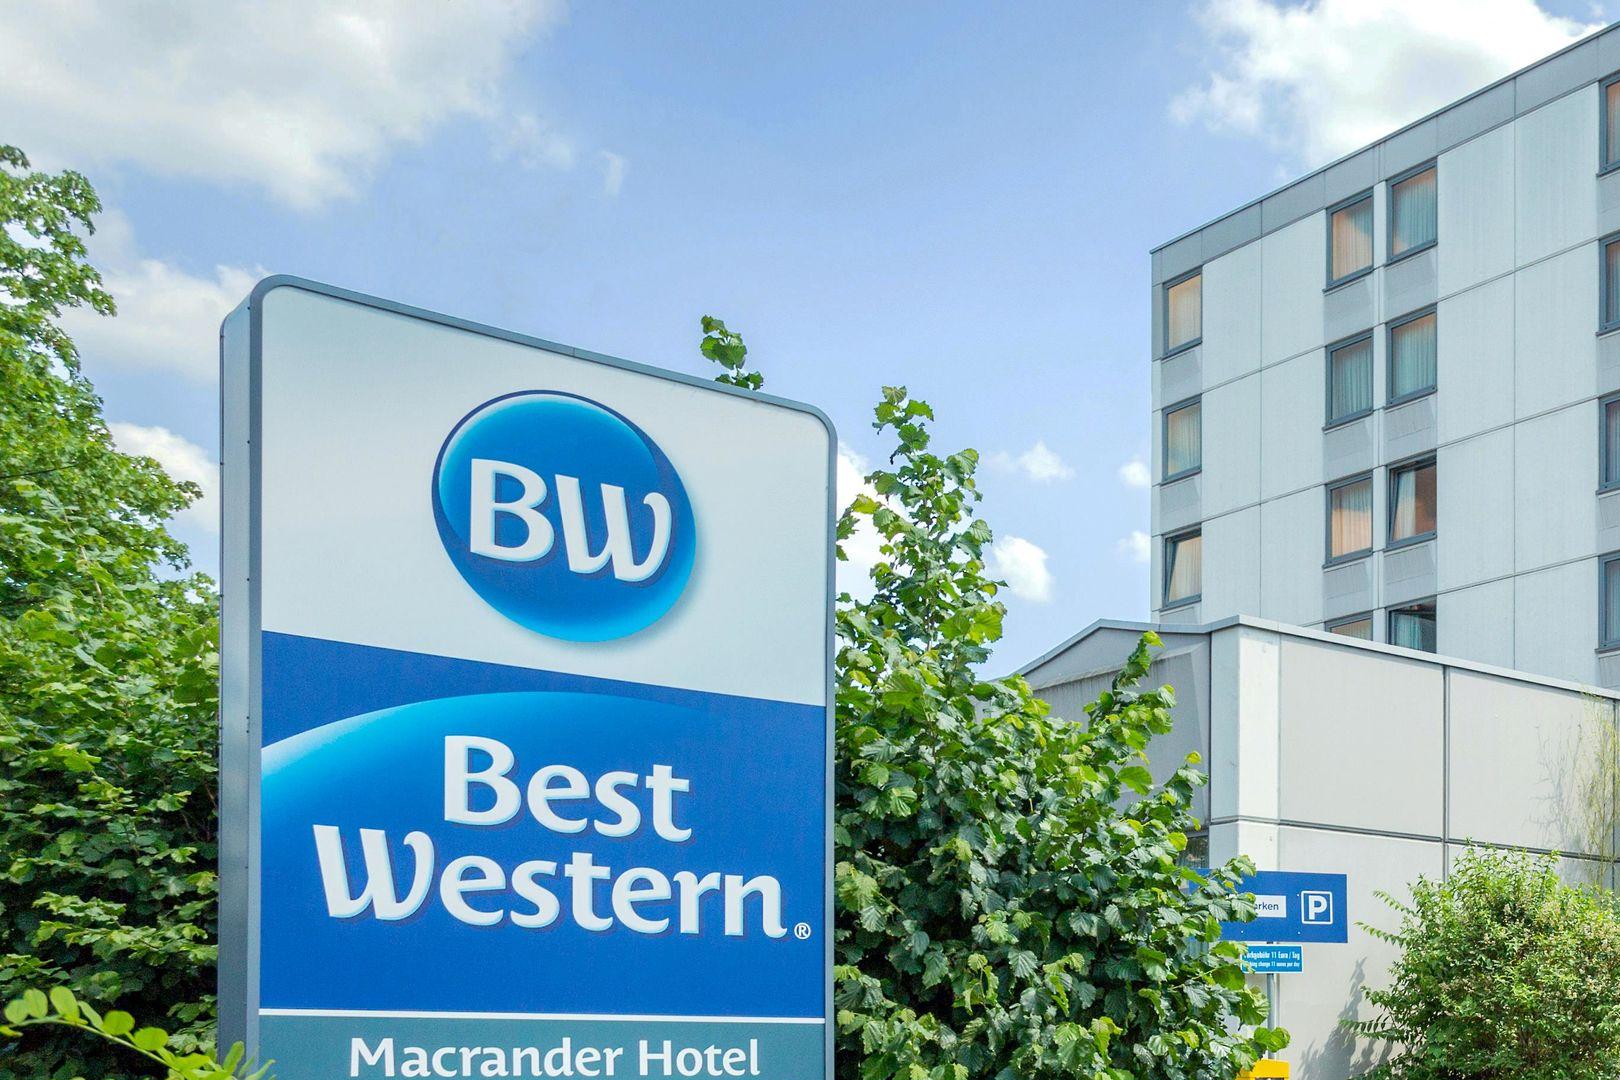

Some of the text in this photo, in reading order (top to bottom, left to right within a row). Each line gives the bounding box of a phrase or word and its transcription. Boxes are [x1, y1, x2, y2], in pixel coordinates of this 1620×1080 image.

[469, 457, 672, 584] BW
[443, 735, 692, 843] Best
[1253, 901, 1279, 911] arken
[1308, 895, 1328, 920] P
[350, 1037, 760, 1078] Macrander Hotel
